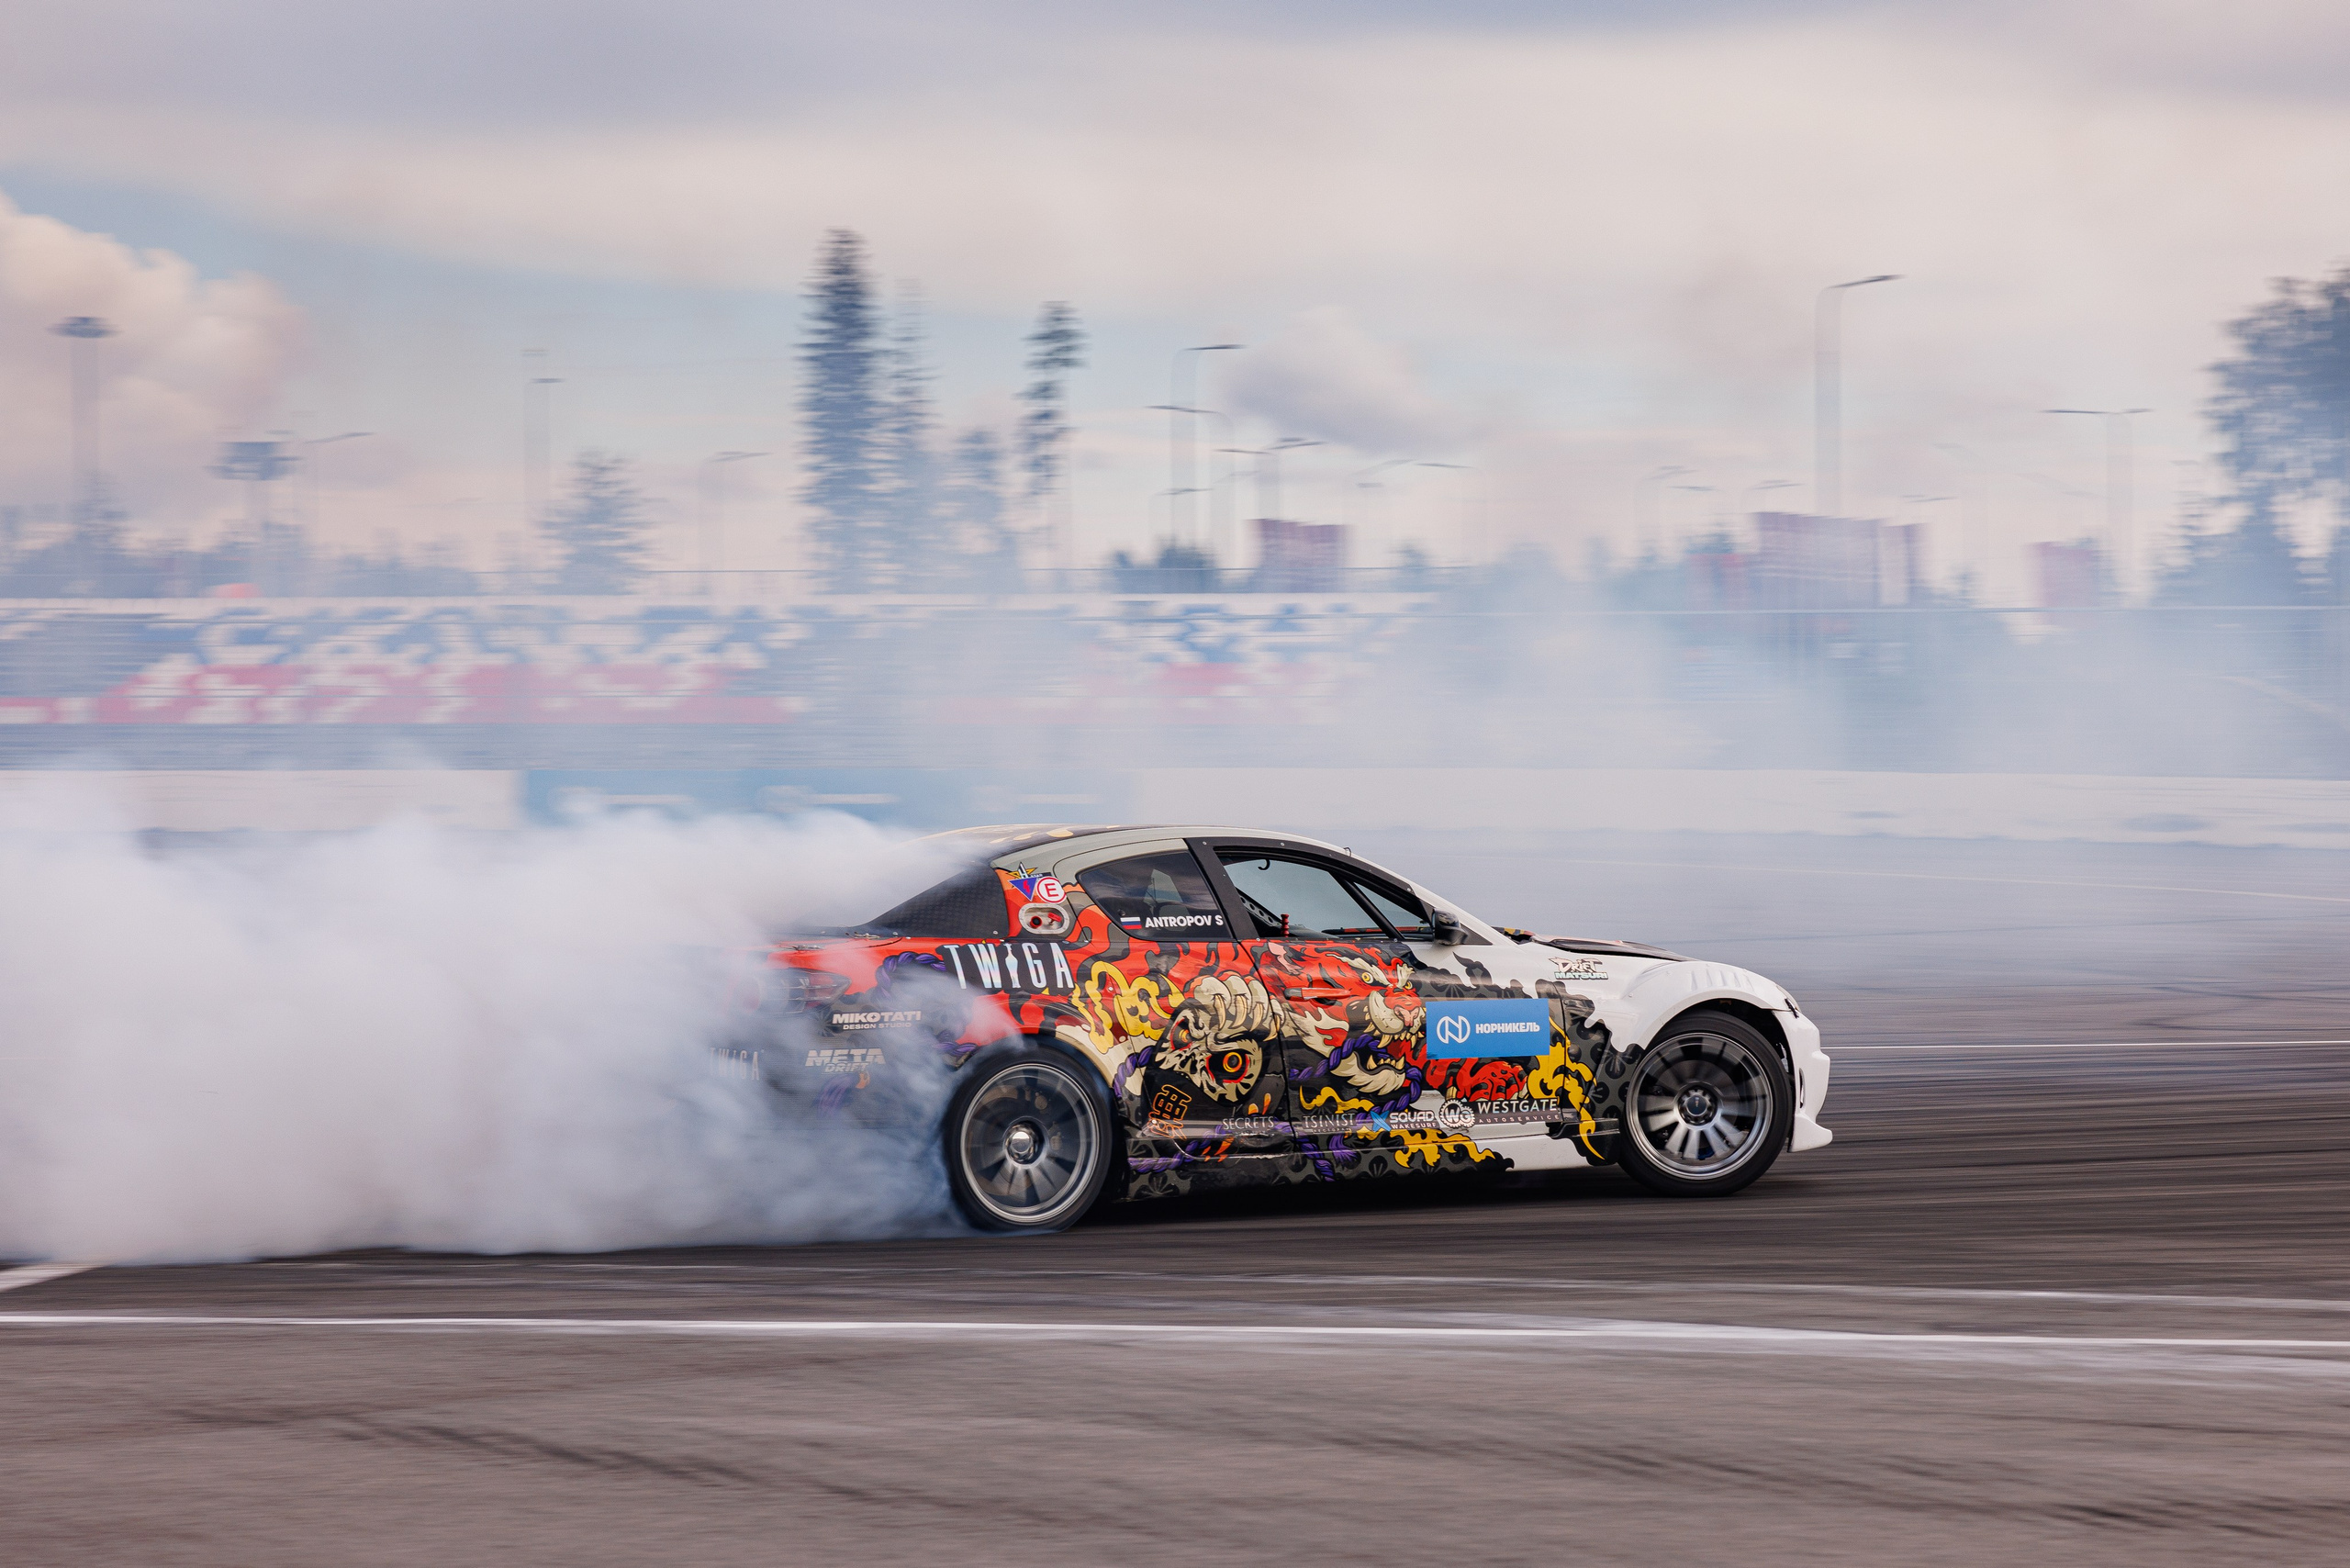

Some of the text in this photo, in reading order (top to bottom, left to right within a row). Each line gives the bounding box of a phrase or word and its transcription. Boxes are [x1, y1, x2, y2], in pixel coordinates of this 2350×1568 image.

[1044, 882, 1059, 898] E
[1145, 914, 1224, 928] ANTROPOV S
[1554, 971, 1608, 980] MATSURI
[832, 1011, 922, 1025] MIKOTATI
[1475, 1022, 1540, 1034] НОРНИКЕЛЬ
[805, 1048, 886, 1067] META
[825, 1063, 869, 1073] DRIFT
[1478, 1099, 1558, 1114] WESTGATE
[1222, 1116, 1275, 1130] SECRETS
[1389, 1112, 1435, 1123] SQUAD
[1479, 1114, 1560, 1124] AUTOSERVICE
